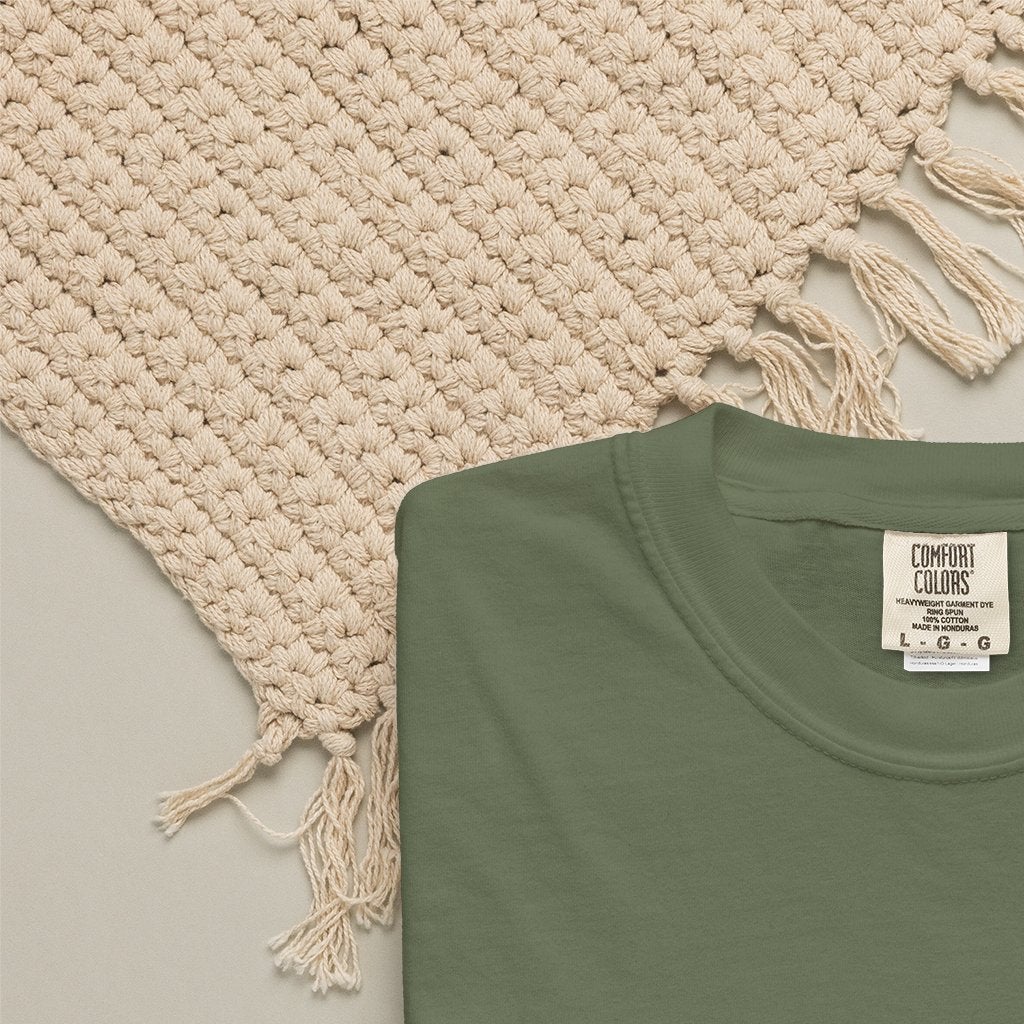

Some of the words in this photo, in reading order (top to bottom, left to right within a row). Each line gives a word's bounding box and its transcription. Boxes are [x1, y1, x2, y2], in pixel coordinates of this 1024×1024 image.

[911, 543, 976, 569] COMFORT
[896, 598, 944, 608] HEAVYWEIGHT
[945, 600, 979, 609] GARMENT
[926, 608, 944, 616] RING
[922, 616, 940, 624] 100%
[940, 617, 969, 625] COTTON
[912, 623, 932, 632] MADE
[900, 632, 910, 648] L
[936, 635, 951, 650] G
[977, 635, 991, 651] G
